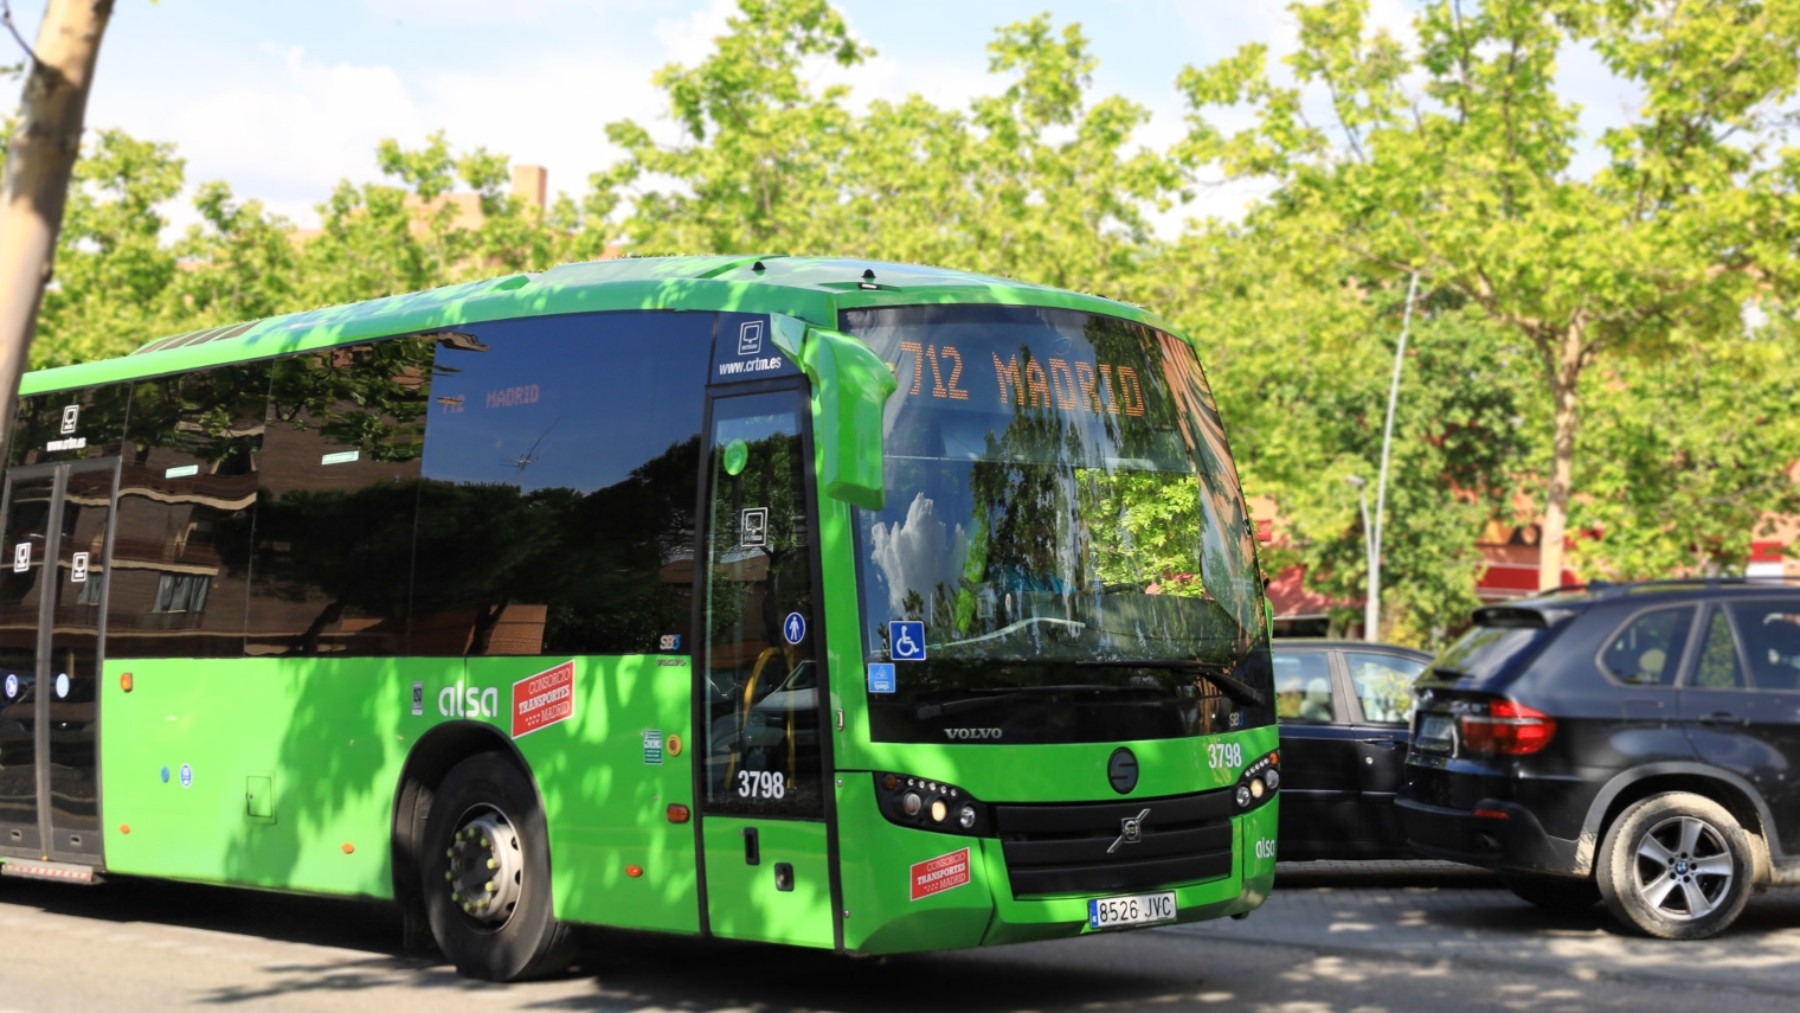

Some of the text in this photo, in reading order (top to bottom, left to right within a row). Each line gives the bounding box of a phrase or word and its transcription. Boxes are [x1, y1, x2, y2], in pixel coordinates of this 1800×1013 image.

[719, 357, 782, 375] www.crtm.es
[900, 341, 1145, 417] 712 MADRID
[528, 667, 571, 695] CONSORCIO
[437, 679, 499, 718] alsa
[518, 684, 571, 716] TRANSPORTES
[540, 700, 571, 723] MADRID
[943, 727, 1003, 740] VOLVO
[1207, 742, 1243, 769] 3798
[738, 769, 785, 799] 3798
[1255, 836, 1276, 860] alsa
[1098, 900, 1140, 923] 8526
[1143, 896, 1172, 919] JVC
